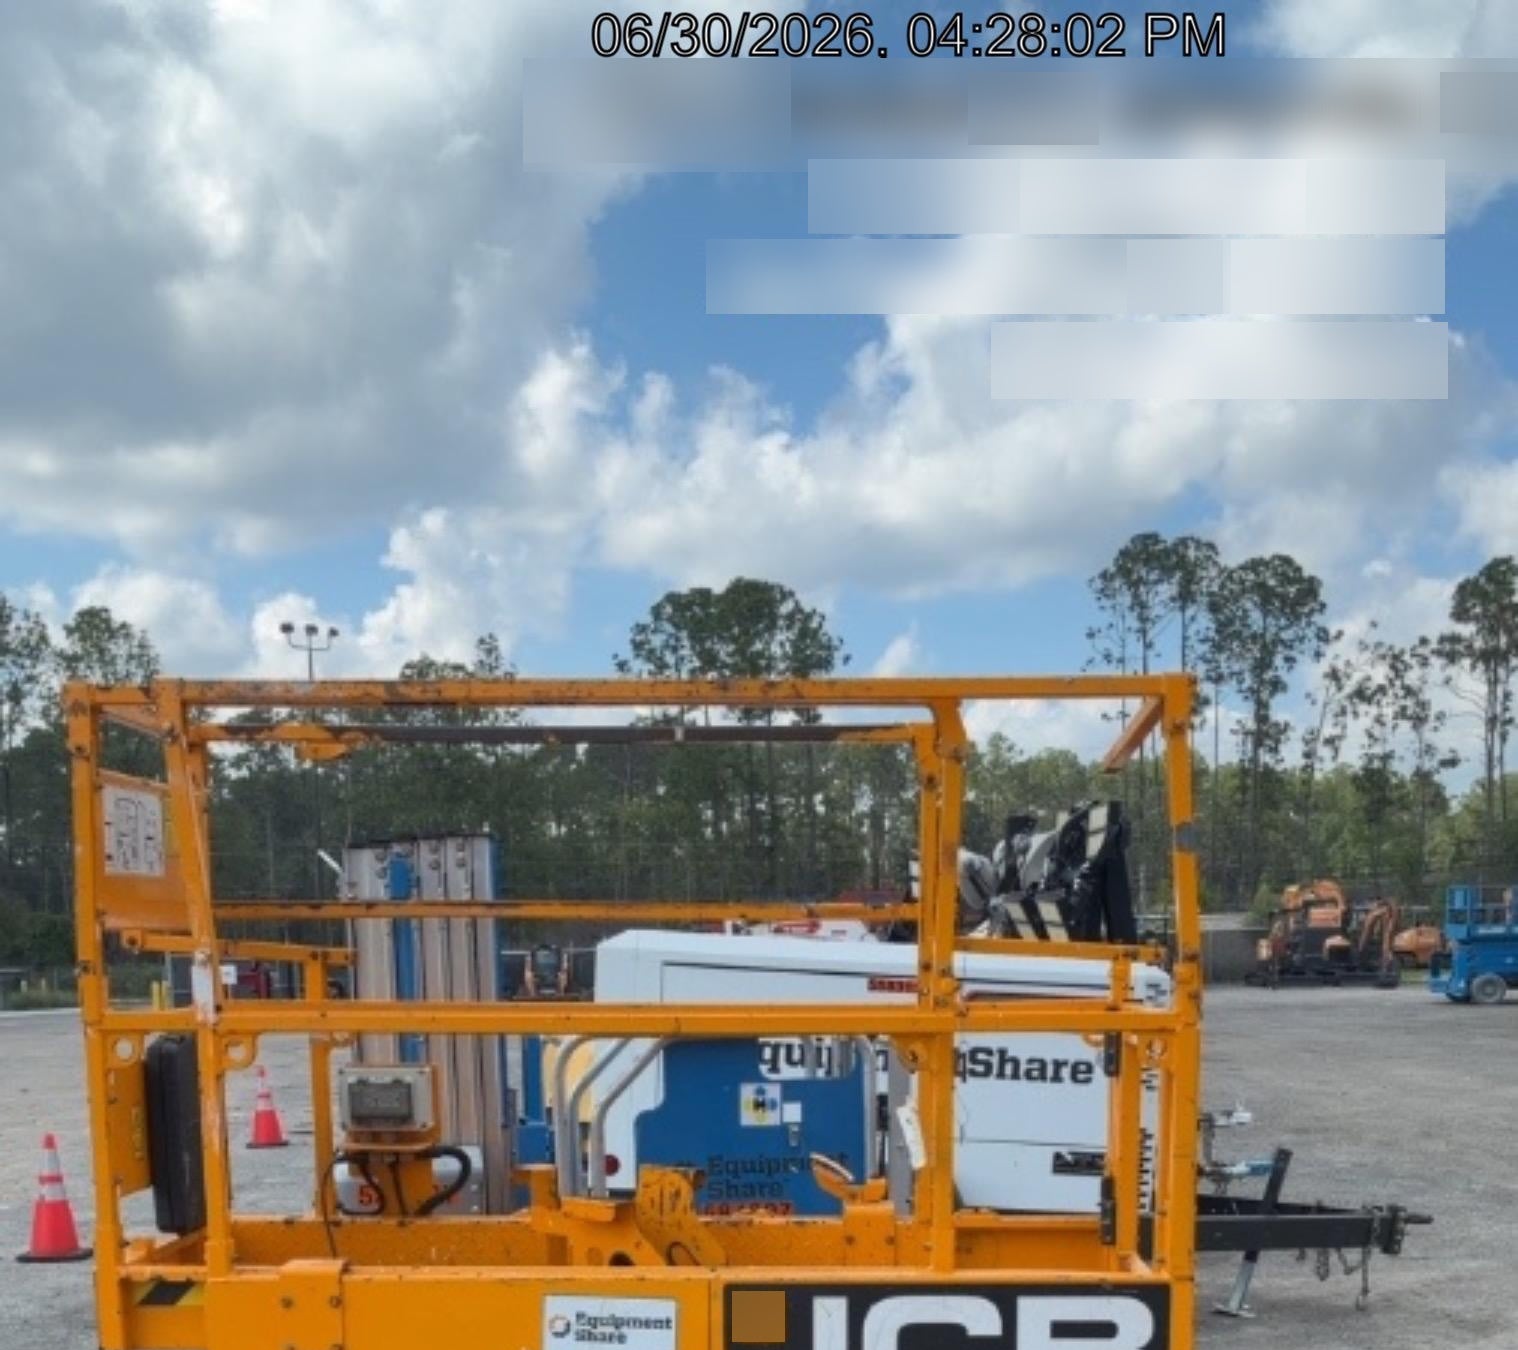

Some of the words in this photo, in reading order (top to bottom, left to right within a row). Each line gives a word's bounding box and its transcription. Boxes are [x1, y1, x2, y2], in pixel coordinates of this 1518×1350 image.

[708, 1179, 784, 1199] Share
[575, 1311, 673, 1330] Equipment
[575, 1328, 628, 1344] Share
